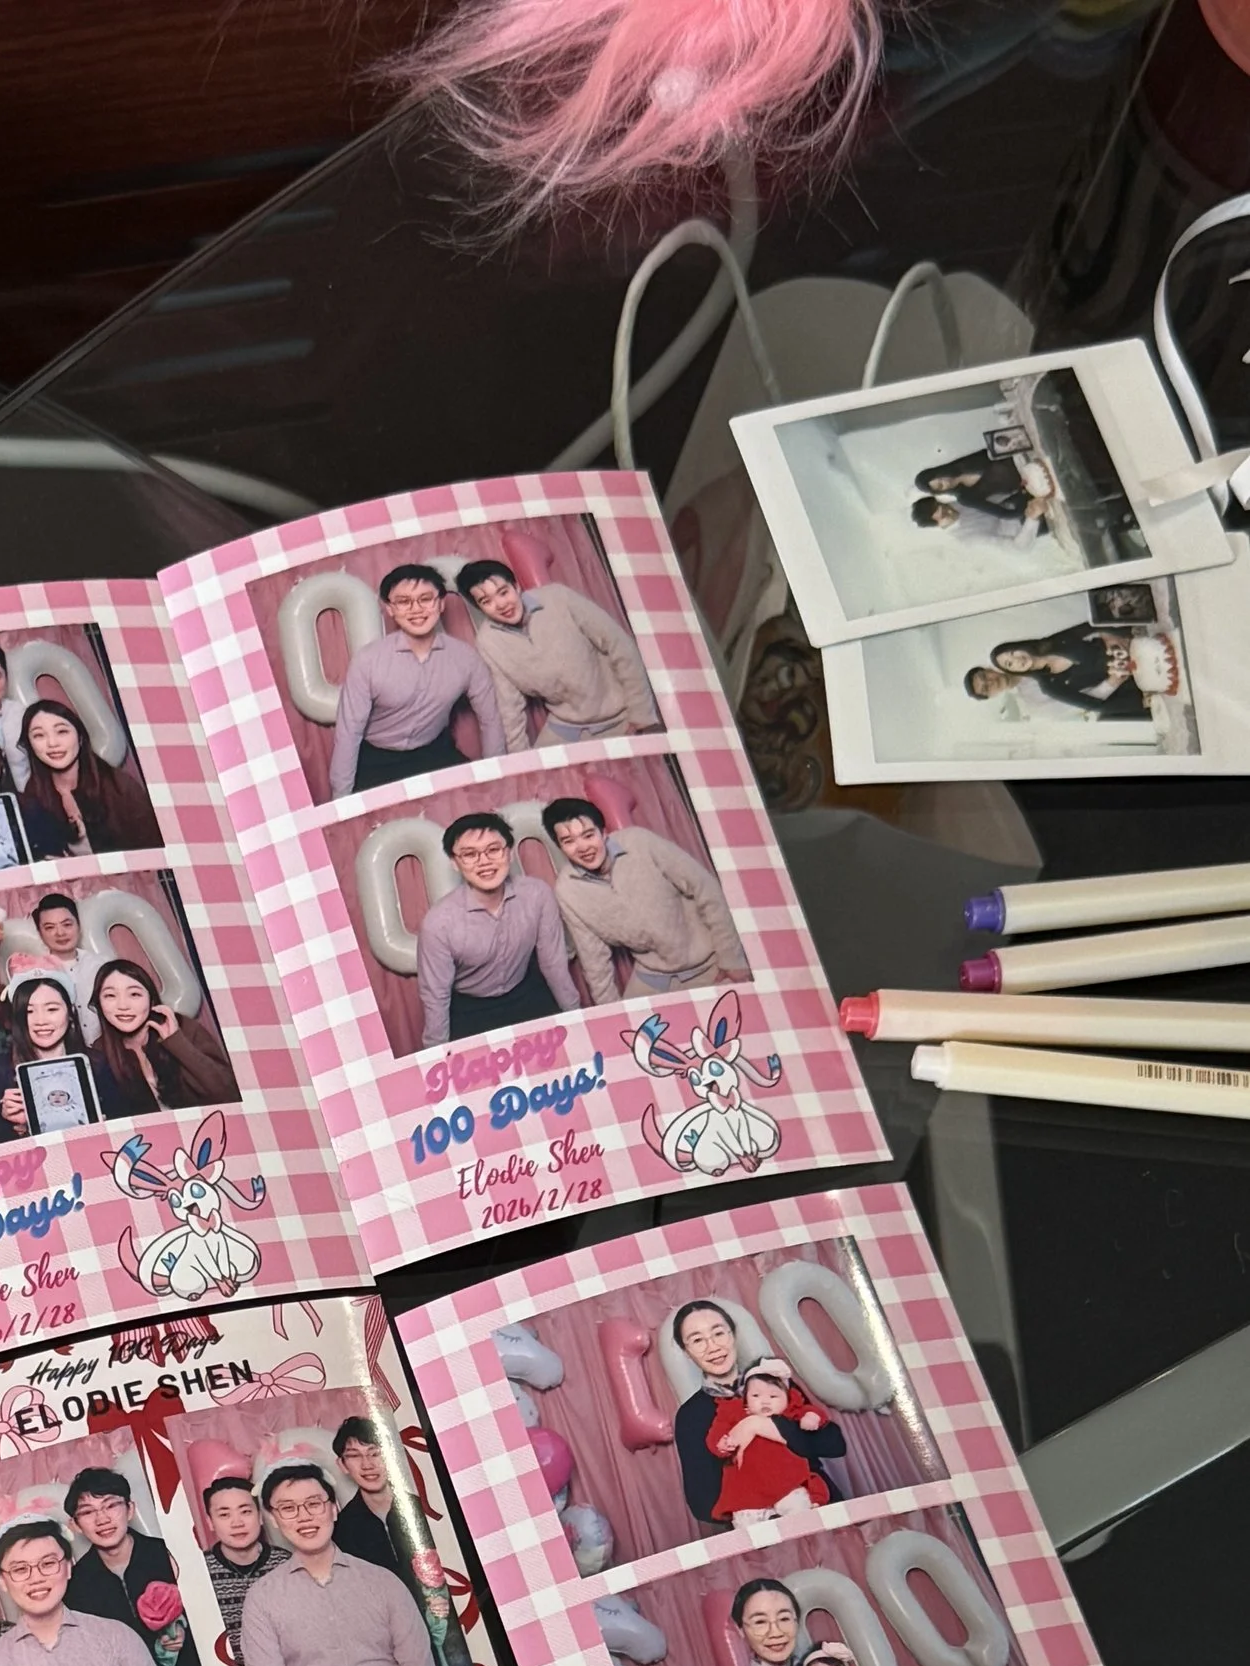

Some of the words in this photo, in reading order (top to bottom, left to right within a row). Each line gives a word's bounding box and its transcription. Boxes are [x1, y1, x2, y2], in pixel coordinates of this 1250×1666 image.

[425, 1025, 567, 1102] Happy
[411, 1110, 475, 1164] 100
[490, 1051, 607, 1128] Days!
[457, 1155, 539, 1200] Elodie
[547, 1127, 605, 1178] Shen
[481, 1178, 602, 1229] 2026/2/28
[21, 1251, 80, 1298] Shen
[14, 1380, 146, 1435] ELODIE
[157, 1359, 254, 1399] SHEN
[27, 1358, 99, 1390] Happy
[108, 1335, 156, 1368] 100
[162, 1331, 224, 1359] Days
